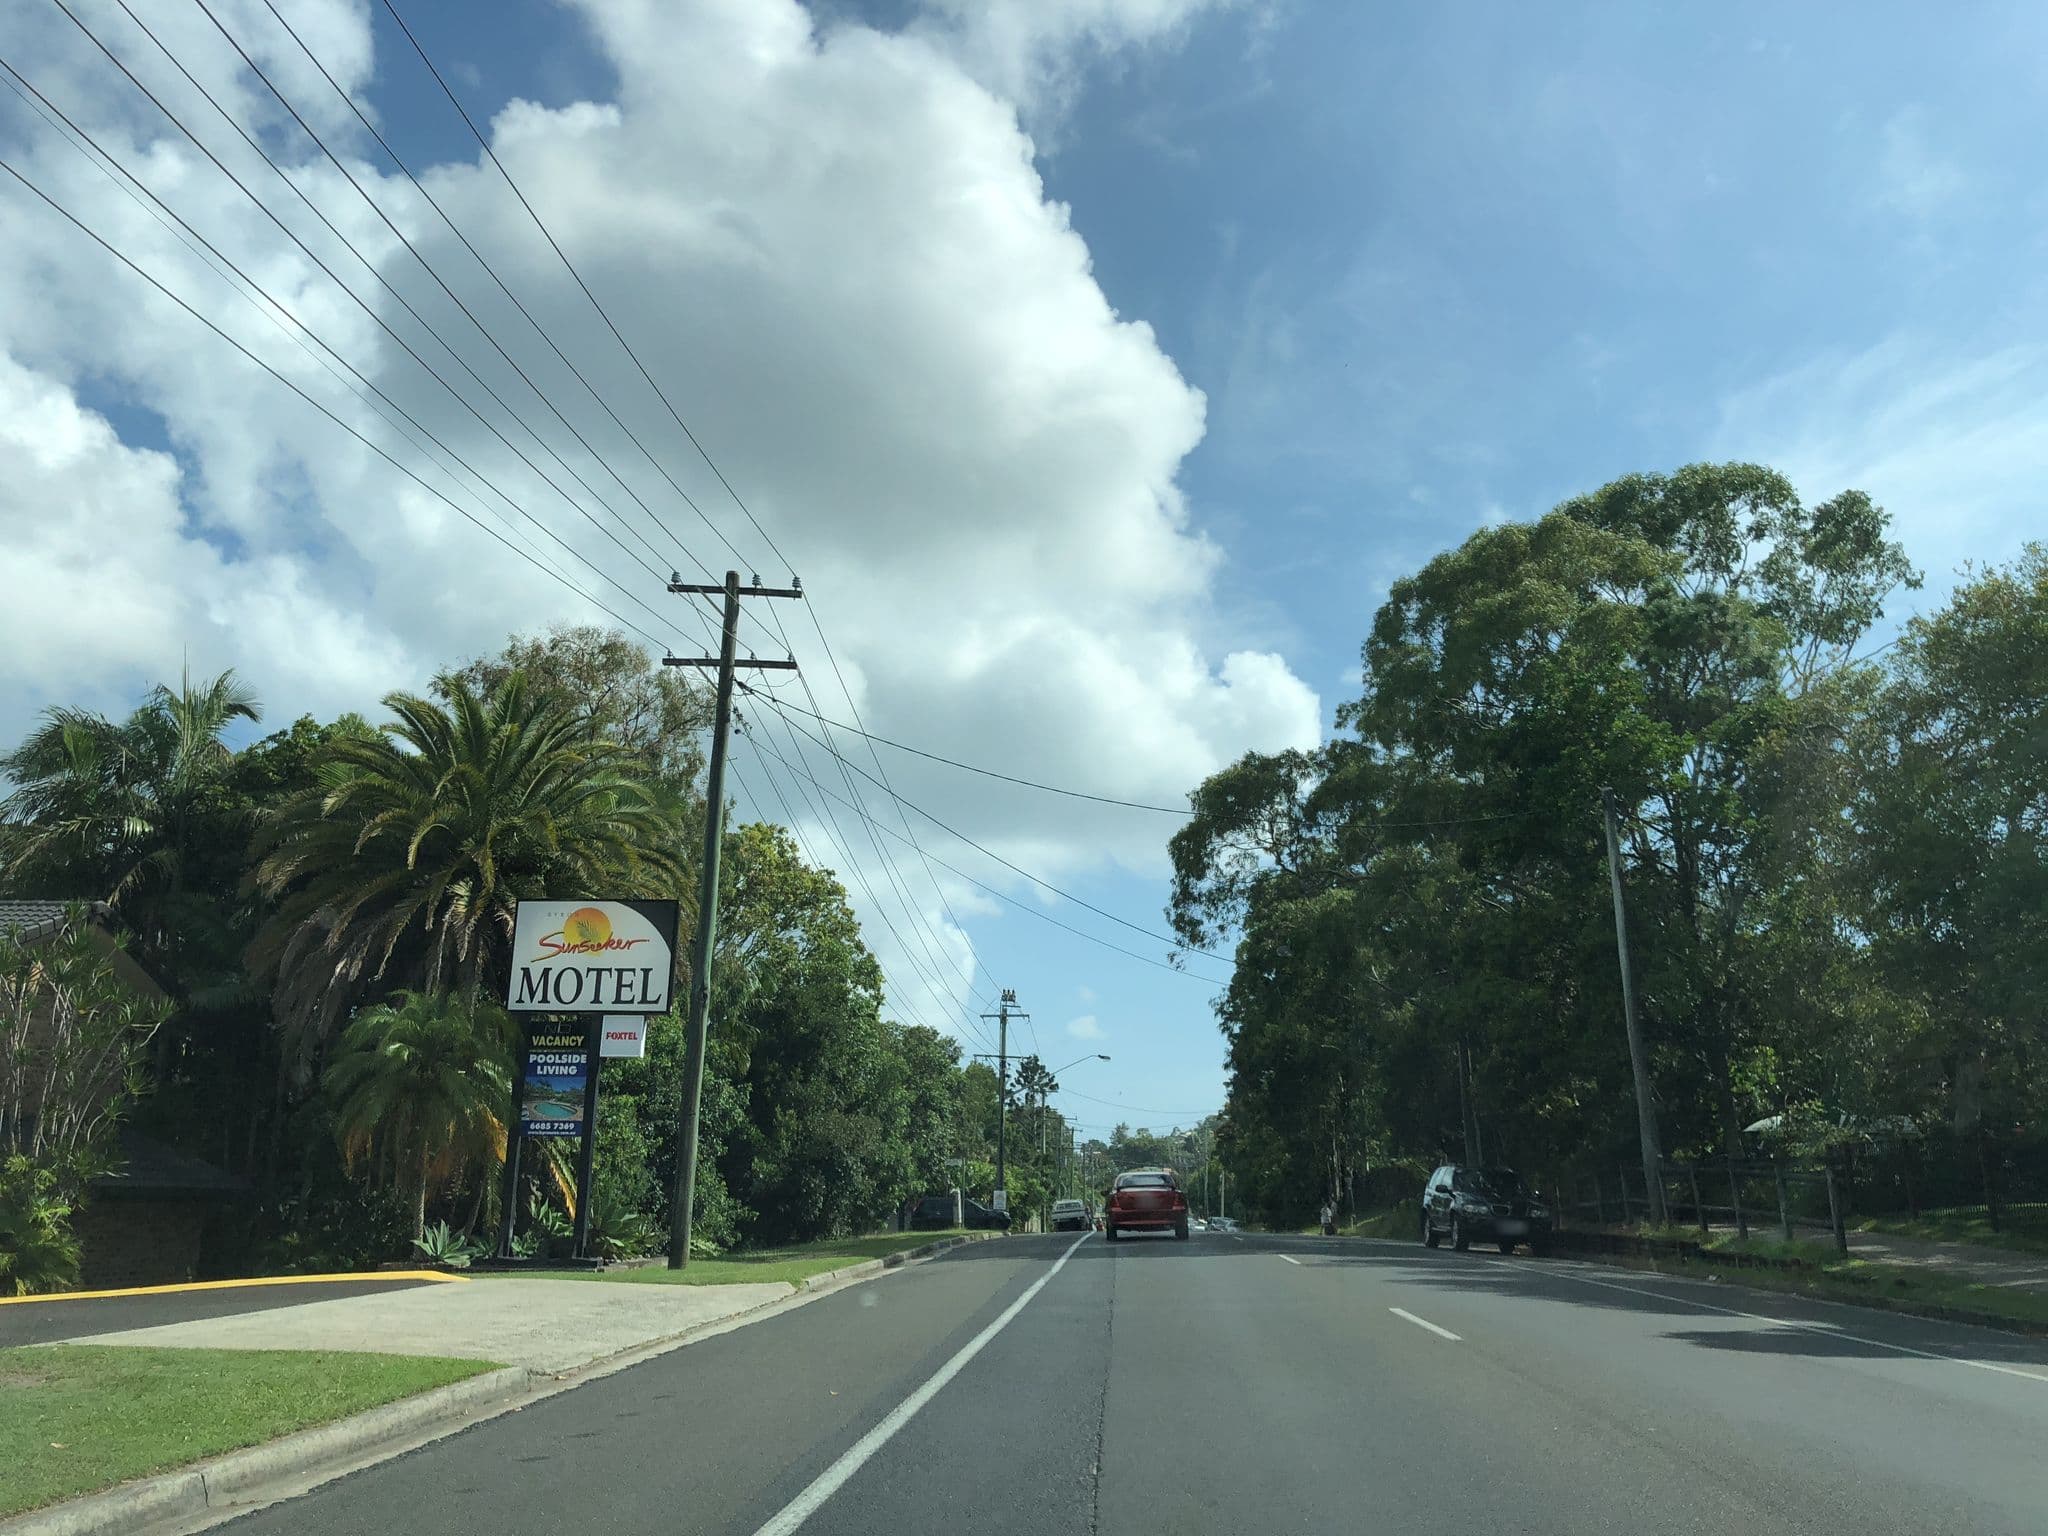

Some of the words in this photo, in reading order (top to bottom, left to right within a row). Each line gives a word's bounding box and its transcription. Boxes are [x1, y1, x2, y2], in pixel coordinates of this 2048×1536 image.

[515, 966, 662, 1005] MOTEL
[532, 1035, 584, 1047] VACANCY
[605, 1032, 638, 1040] FOXTEL
[529, 1054, 587, 1064] POOLSIDE
[536, 1065, 578, 1075] LIVING
[529, 1122, 551, 1130] 6685
[553, 1122, 575, 1130] 7369
